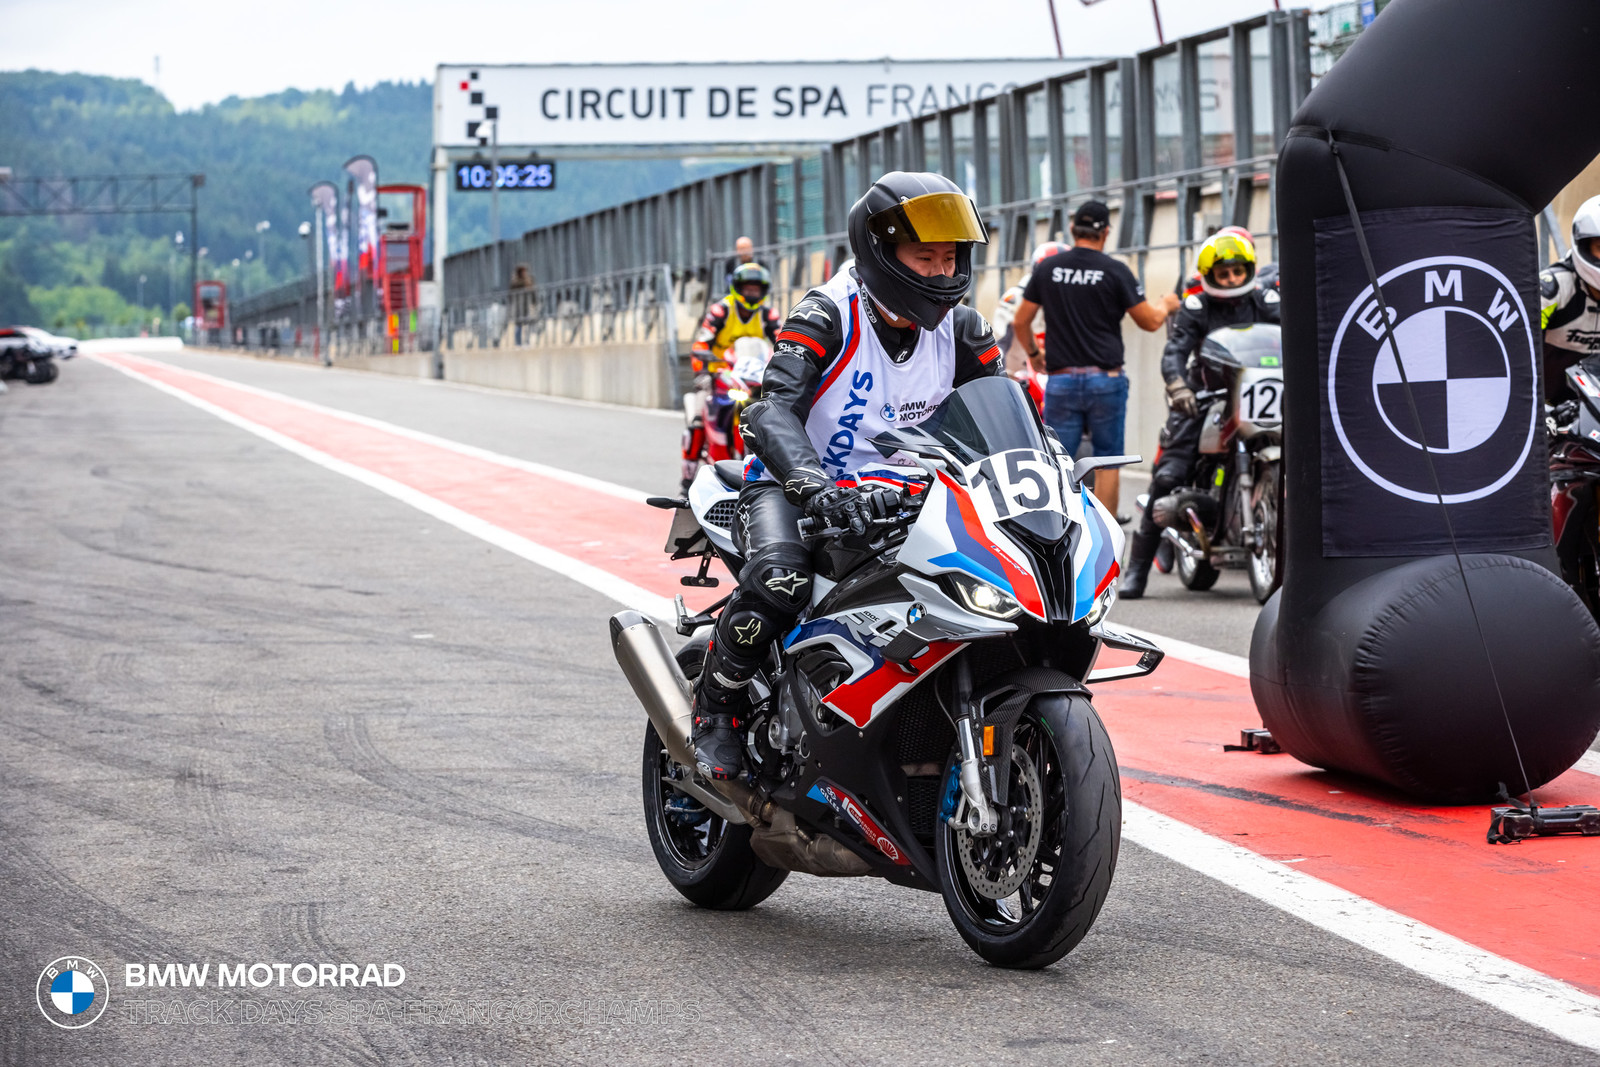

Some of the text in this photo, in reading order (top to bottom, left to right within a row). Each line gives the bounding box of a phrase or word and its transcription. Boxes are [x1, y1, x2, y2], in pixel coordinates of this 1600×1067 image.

[541, 87, 693, 119] CIRCUIT
[708, 86, 758, 118] DE
[773, 86, 848, 117] SPA
[1052, 266, 1104, 285] STAFF
[1355, 269, 1520, 341] BMW
